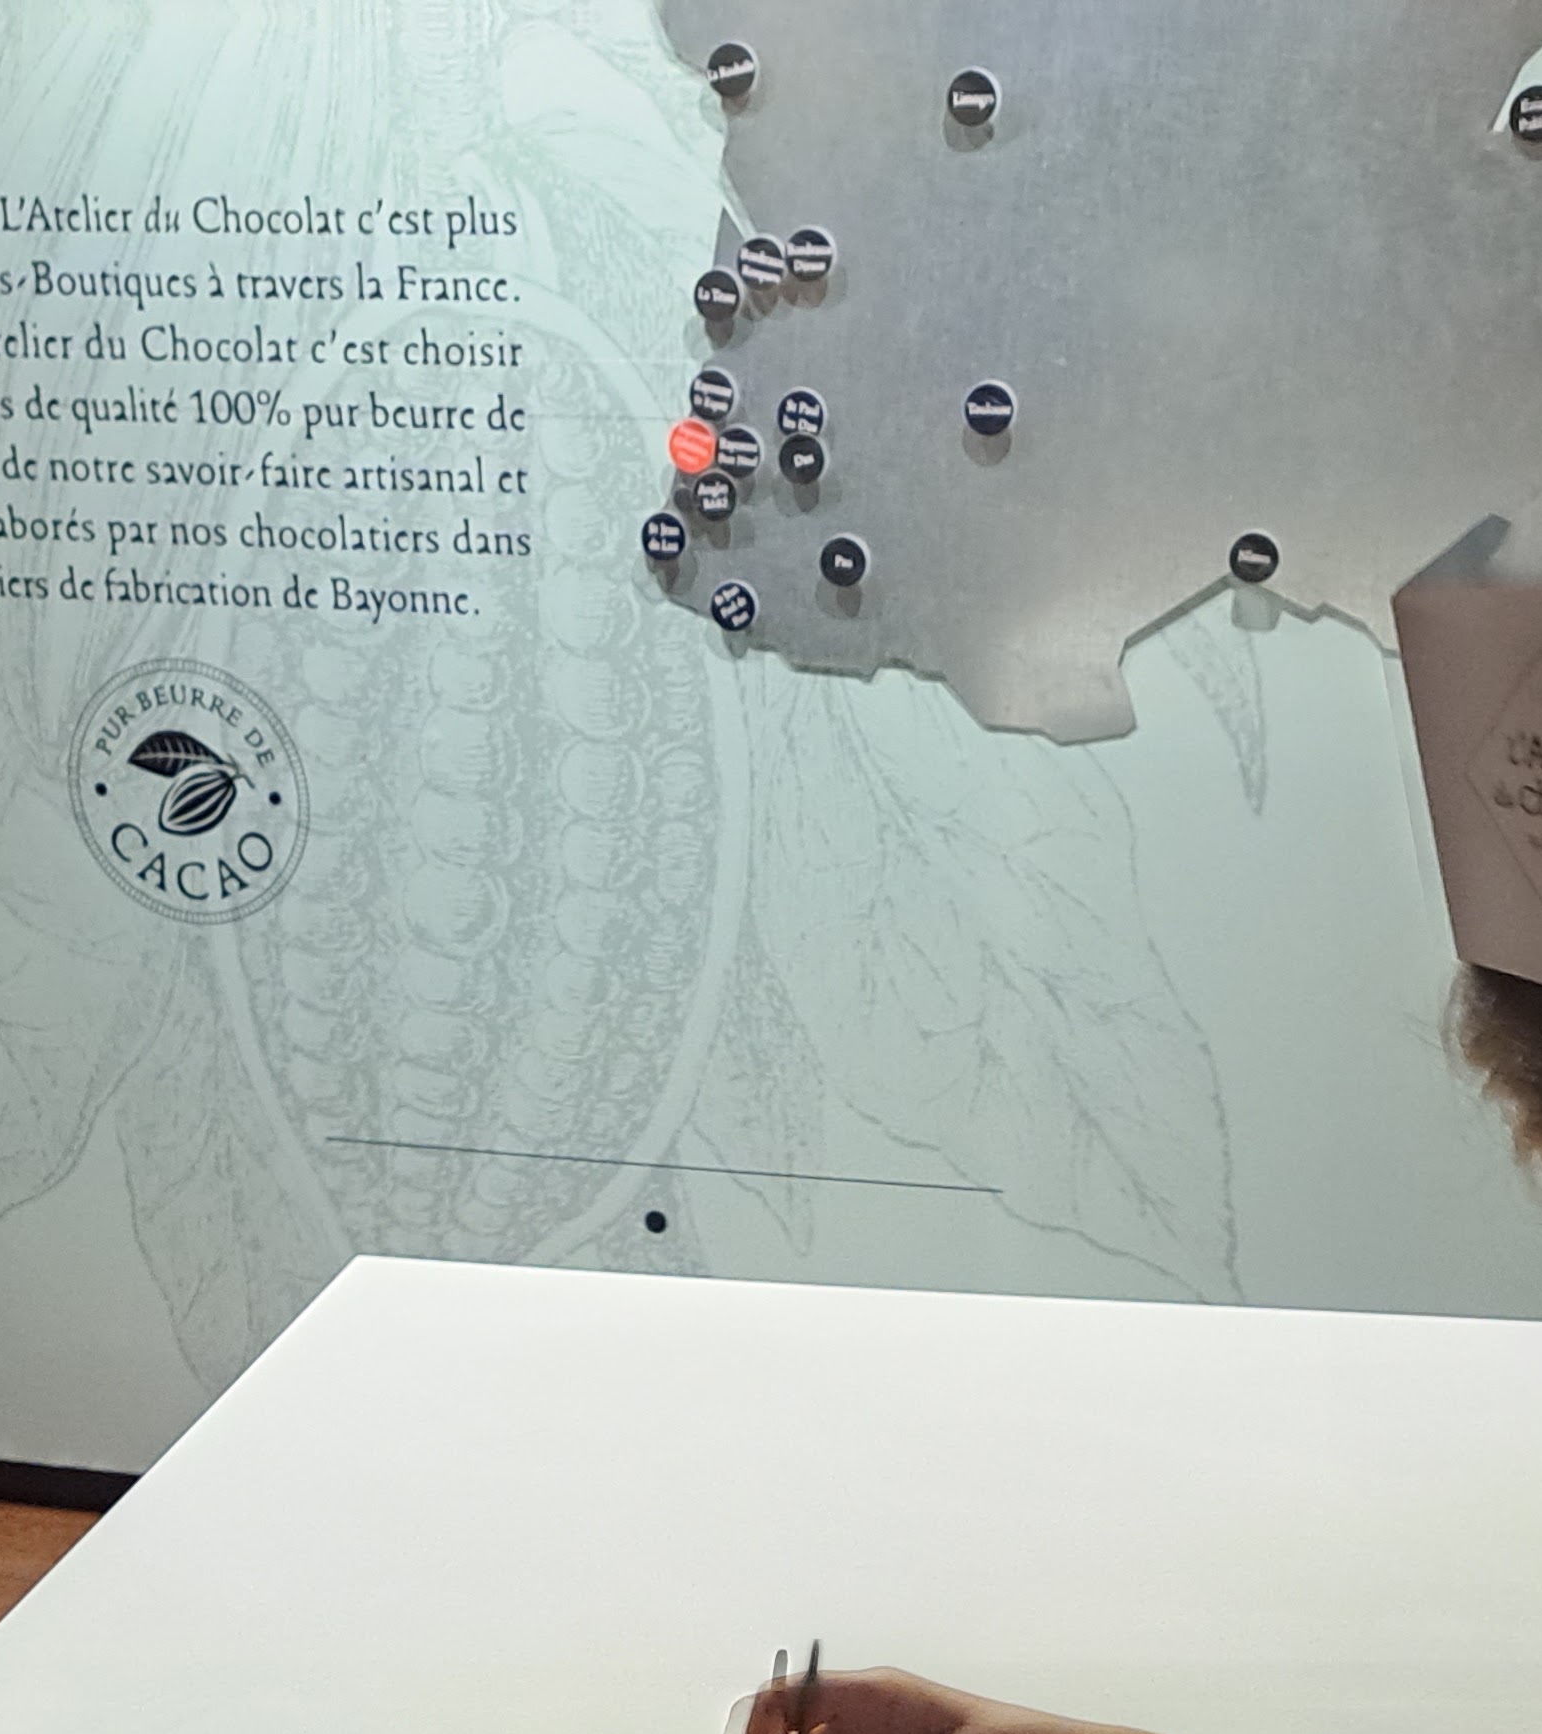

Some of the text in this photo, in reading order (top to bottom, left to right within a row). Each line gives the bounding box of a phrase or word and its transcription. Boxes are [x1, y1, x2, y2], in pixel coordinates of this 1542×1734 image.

[144, 194, 180, 234] du
[192, 194, 346, 236] Chocolat
[357, 198, 434, 236] c'est
[445, 194, 518, 251] plus
[208, 261, 225, 299] à
[236, 272, 344, 301] travers
[355, 260, 384, 301] la
[397, 264, 521, 303] France.
[84, 320, 127, 361] du
[140, 322, 299, 364] Chocolat
[310, 327, 391, 365] c'est
[403, 326, 523, 368] choisir
[24, 383, 61, 421] de
[70, 384, 178, 436] qualité
[189, 388, 292, 427] 100%
[302, 403, 360, 441] pur
[368, 390, 475, 431] beurre
[486, 392, 526, 433] de
[1, 443, 38, 482] de
[48, 457, 136, 484] notre
[146, 450, 332, 490] savoir-faire
[342, 454, 485, 494] artisanal
[497, 467, 529, 495] et
[106, 520, 158, 557] par
[169, 522, 228, 547] nos
[239, 511, 440, 554] chocolatiers
[452, 517, 532, 557] dans
[59, 564, 95, 603] de
[104, 566, 273, 608] fabrication
[282, 572, 319, 610] de
[330, 576, 480, 626] Bayonne.
[95, 683, 276, 769] PUR BEURRE DE
[111, 821, 274, 901] CACAO
